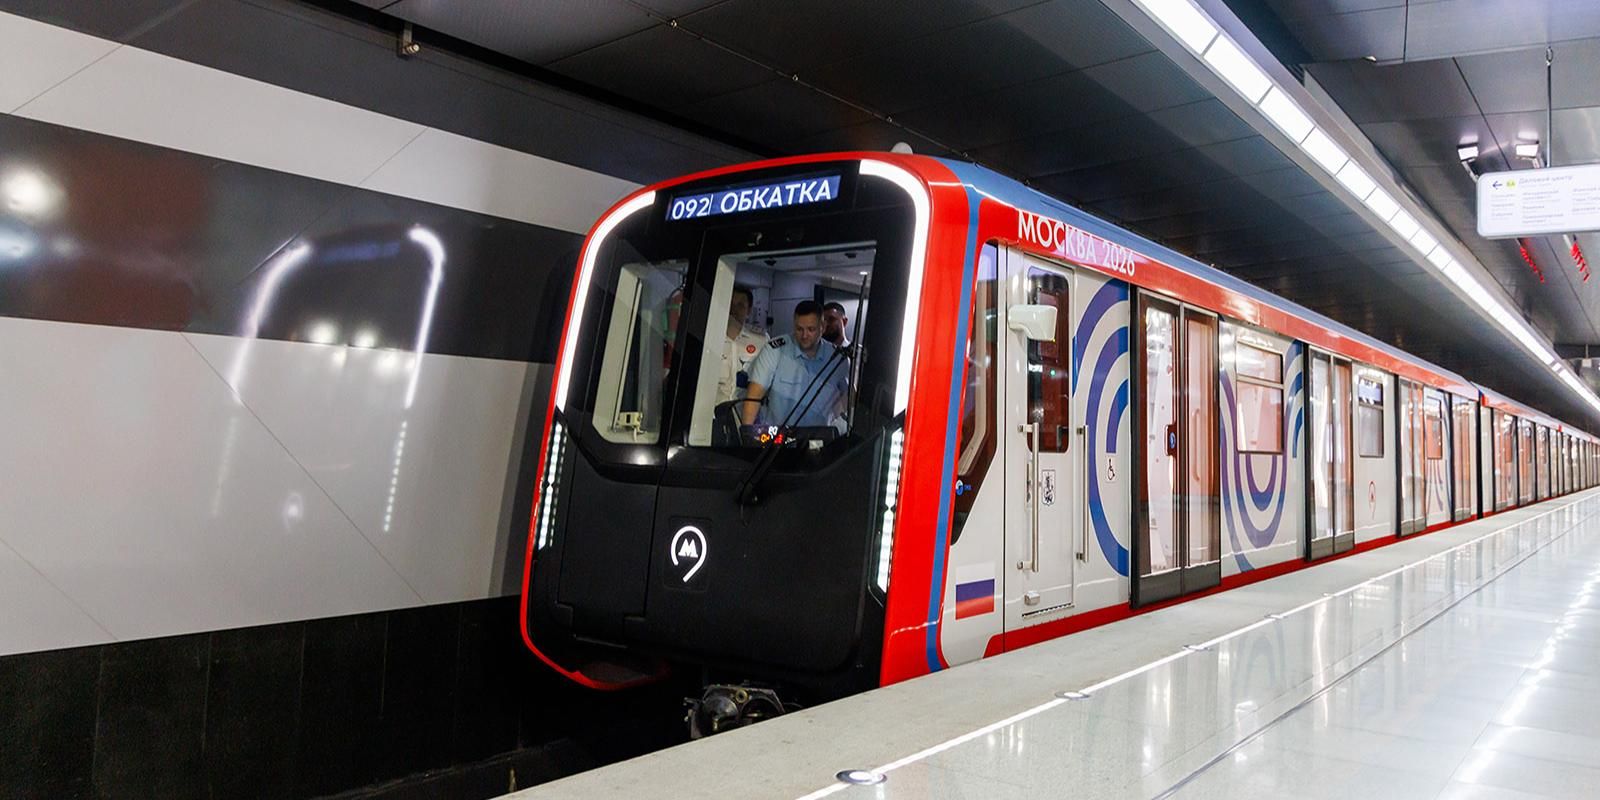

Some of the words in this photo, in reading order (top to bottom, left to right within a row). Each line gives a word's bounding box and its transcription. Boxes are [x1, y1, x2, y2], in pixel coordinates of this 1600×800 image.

[671, 198, 711, 220] 092
[720, 179, 831, 214] ОБКАТКА
[1018, 209, 1097, 263] МОСКВА
[1102, 240, 1135, 276] 2026
